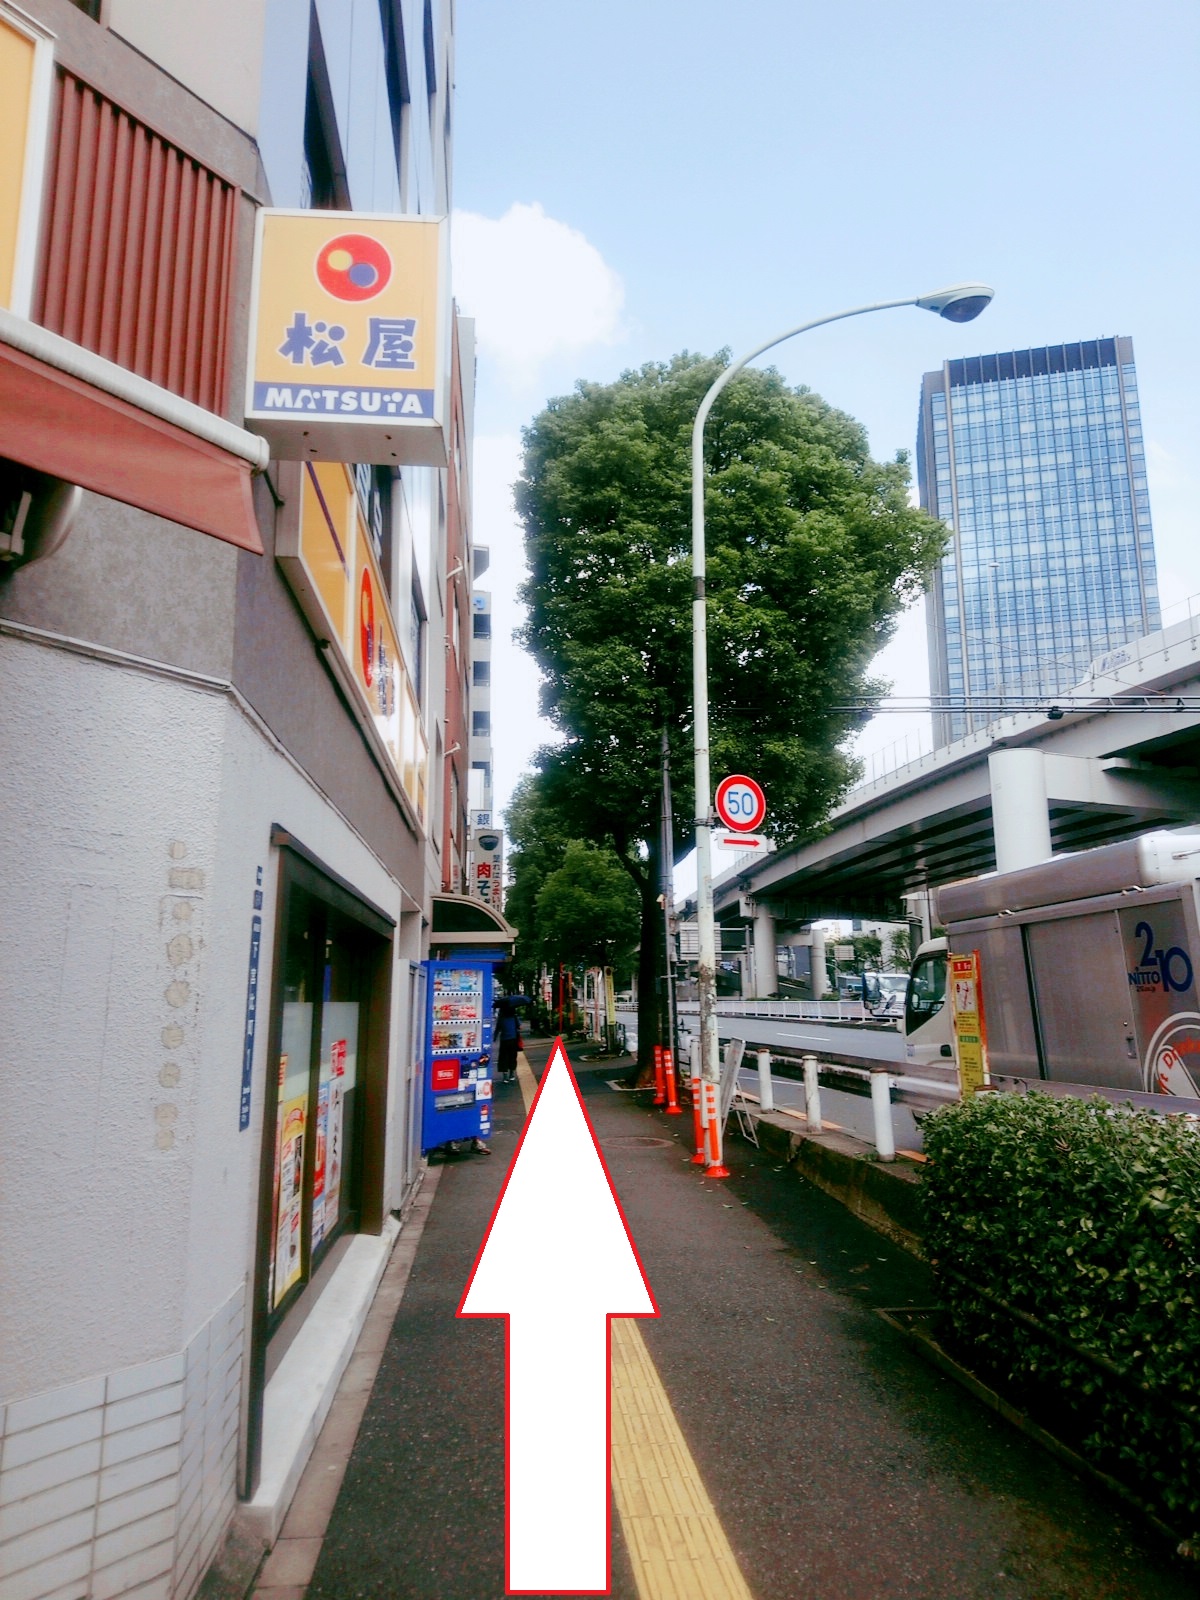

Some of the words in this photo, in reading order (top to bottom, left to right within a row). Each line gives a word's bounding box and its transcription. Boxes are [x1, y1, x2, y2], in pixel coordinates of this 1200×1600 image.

[277, 312, 417, 370] 松屋
[264, 387, 424, 414] MATSUYA
[727, 791, 754, 816] 50
